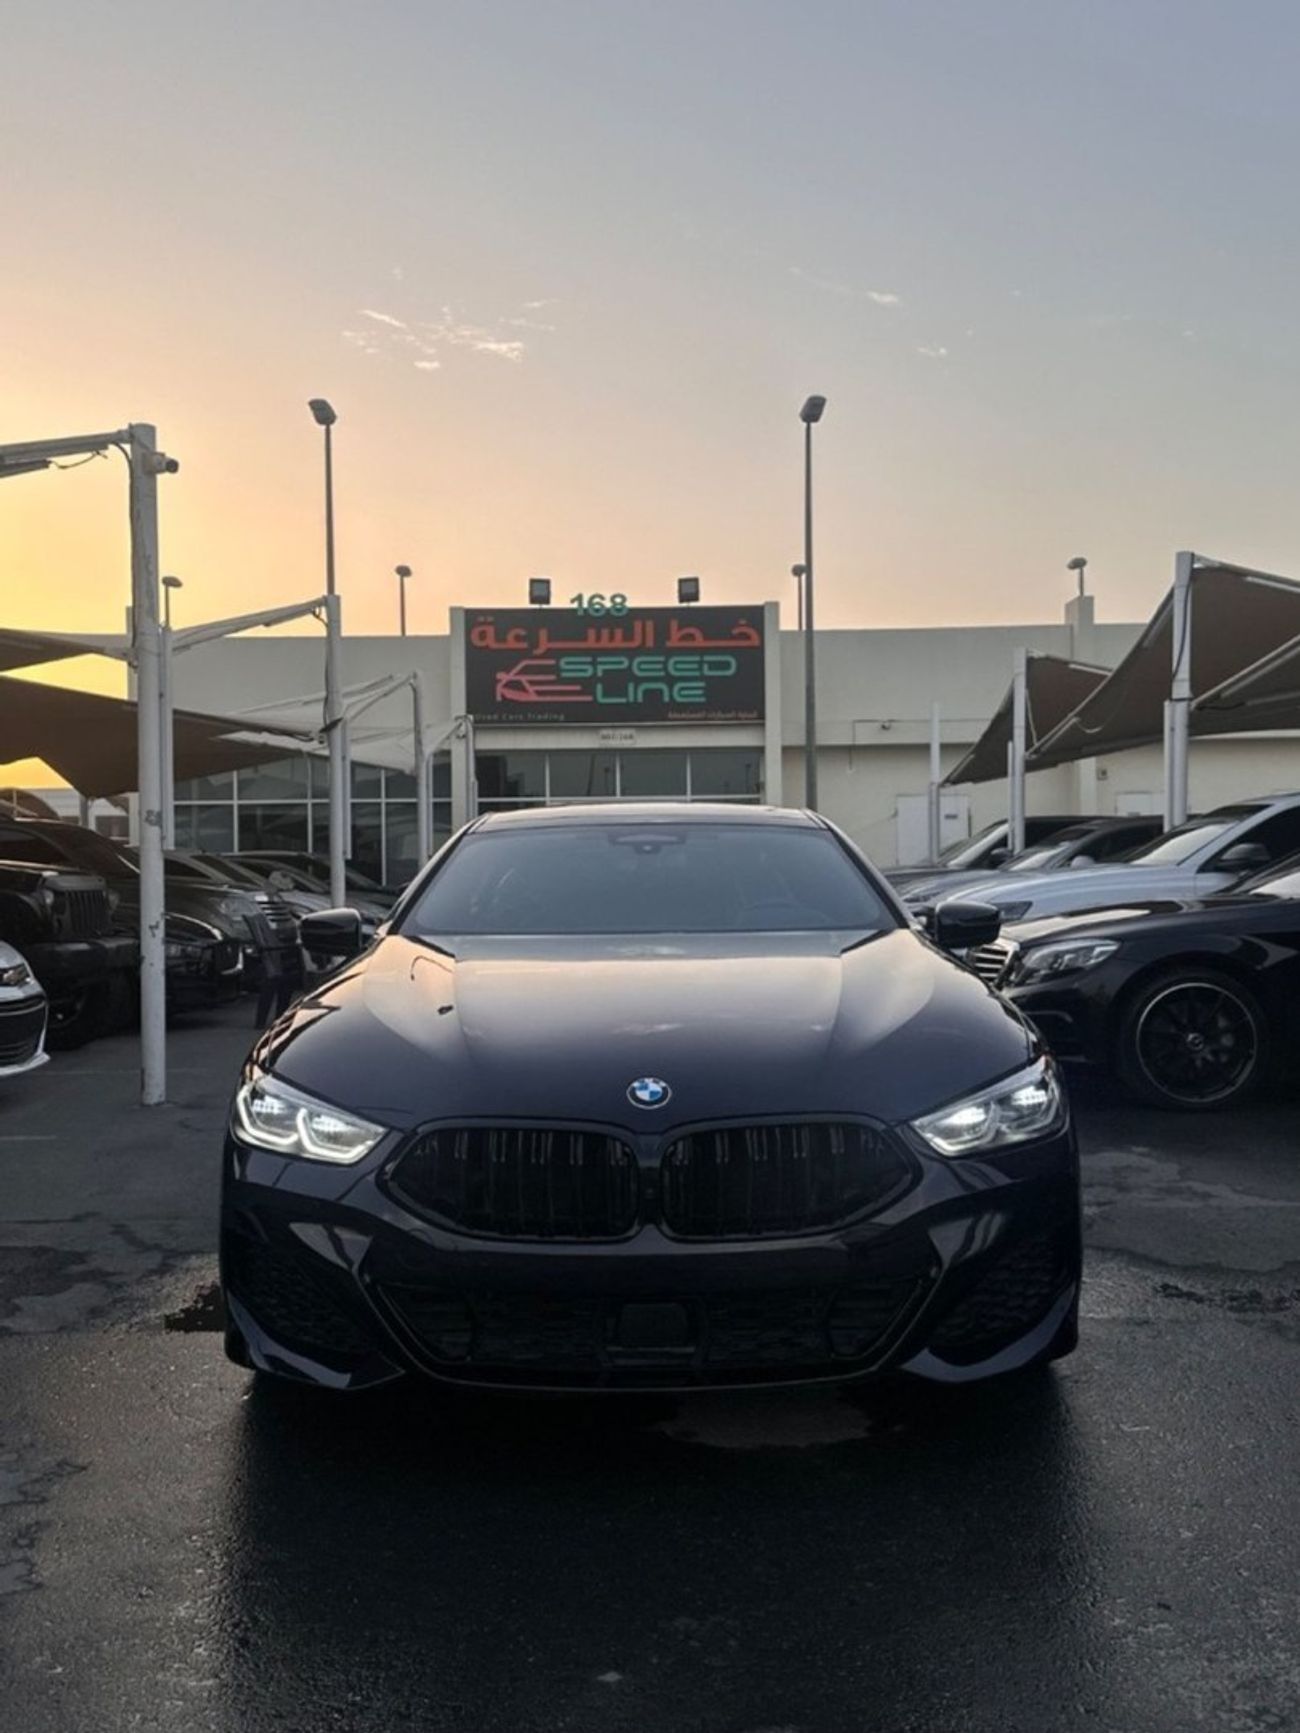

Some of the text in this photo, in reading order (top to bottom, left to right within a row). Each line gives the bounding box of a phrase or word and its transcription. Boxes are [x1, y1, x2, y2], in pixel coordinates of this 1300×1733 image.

[570, 593, 629, 617] 168
[470, 616, 761, 655] خط السرعة
[559, 655, 737, 677] SPEED
[596, 682, 706, 704] LINE
